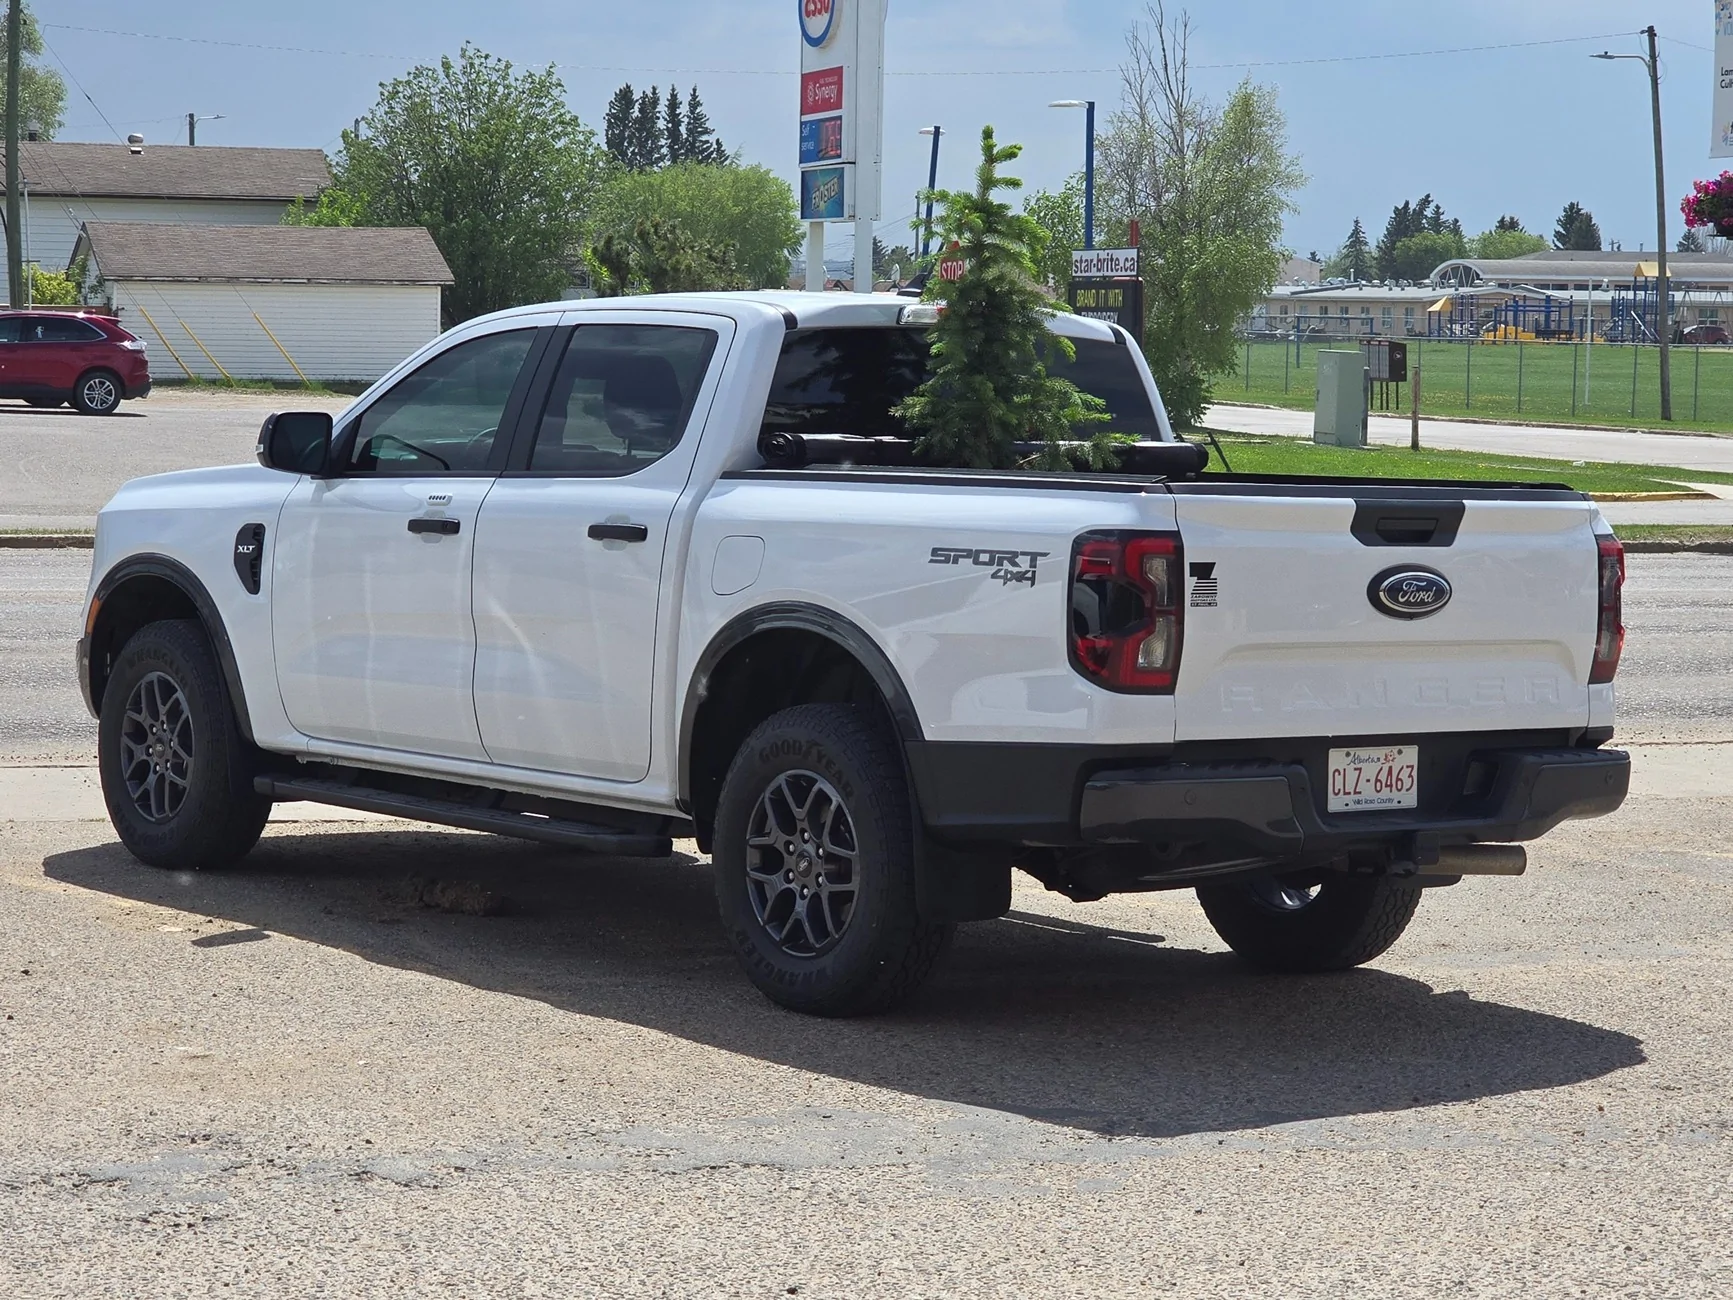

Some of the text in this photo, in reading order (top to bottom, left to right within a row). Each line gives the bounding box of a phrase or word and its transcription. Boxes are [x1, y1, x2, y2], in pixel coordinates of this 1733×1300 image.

[815, 83, 838, 105] Synergy
[941, 260, 964, 280] STOP
[1073, 252, 1136, 274] star-brite.ca
[1076, 288, 1123, 307] BRAND IT WITH
[237, 545, 256, 553] XLT
[928, 546, 1051, 569] SPORT
[1398, 580, 1436, 603] Ford
[1220, 675, 1562, 712] RANGER
[759, 738, 855, 799] GOODYEAR
[1347, 751, 1378, 766] Alberta
[1332, 764, 1415, 797] CLZ-6463
[1352, 798, 1363, 806] Wild
